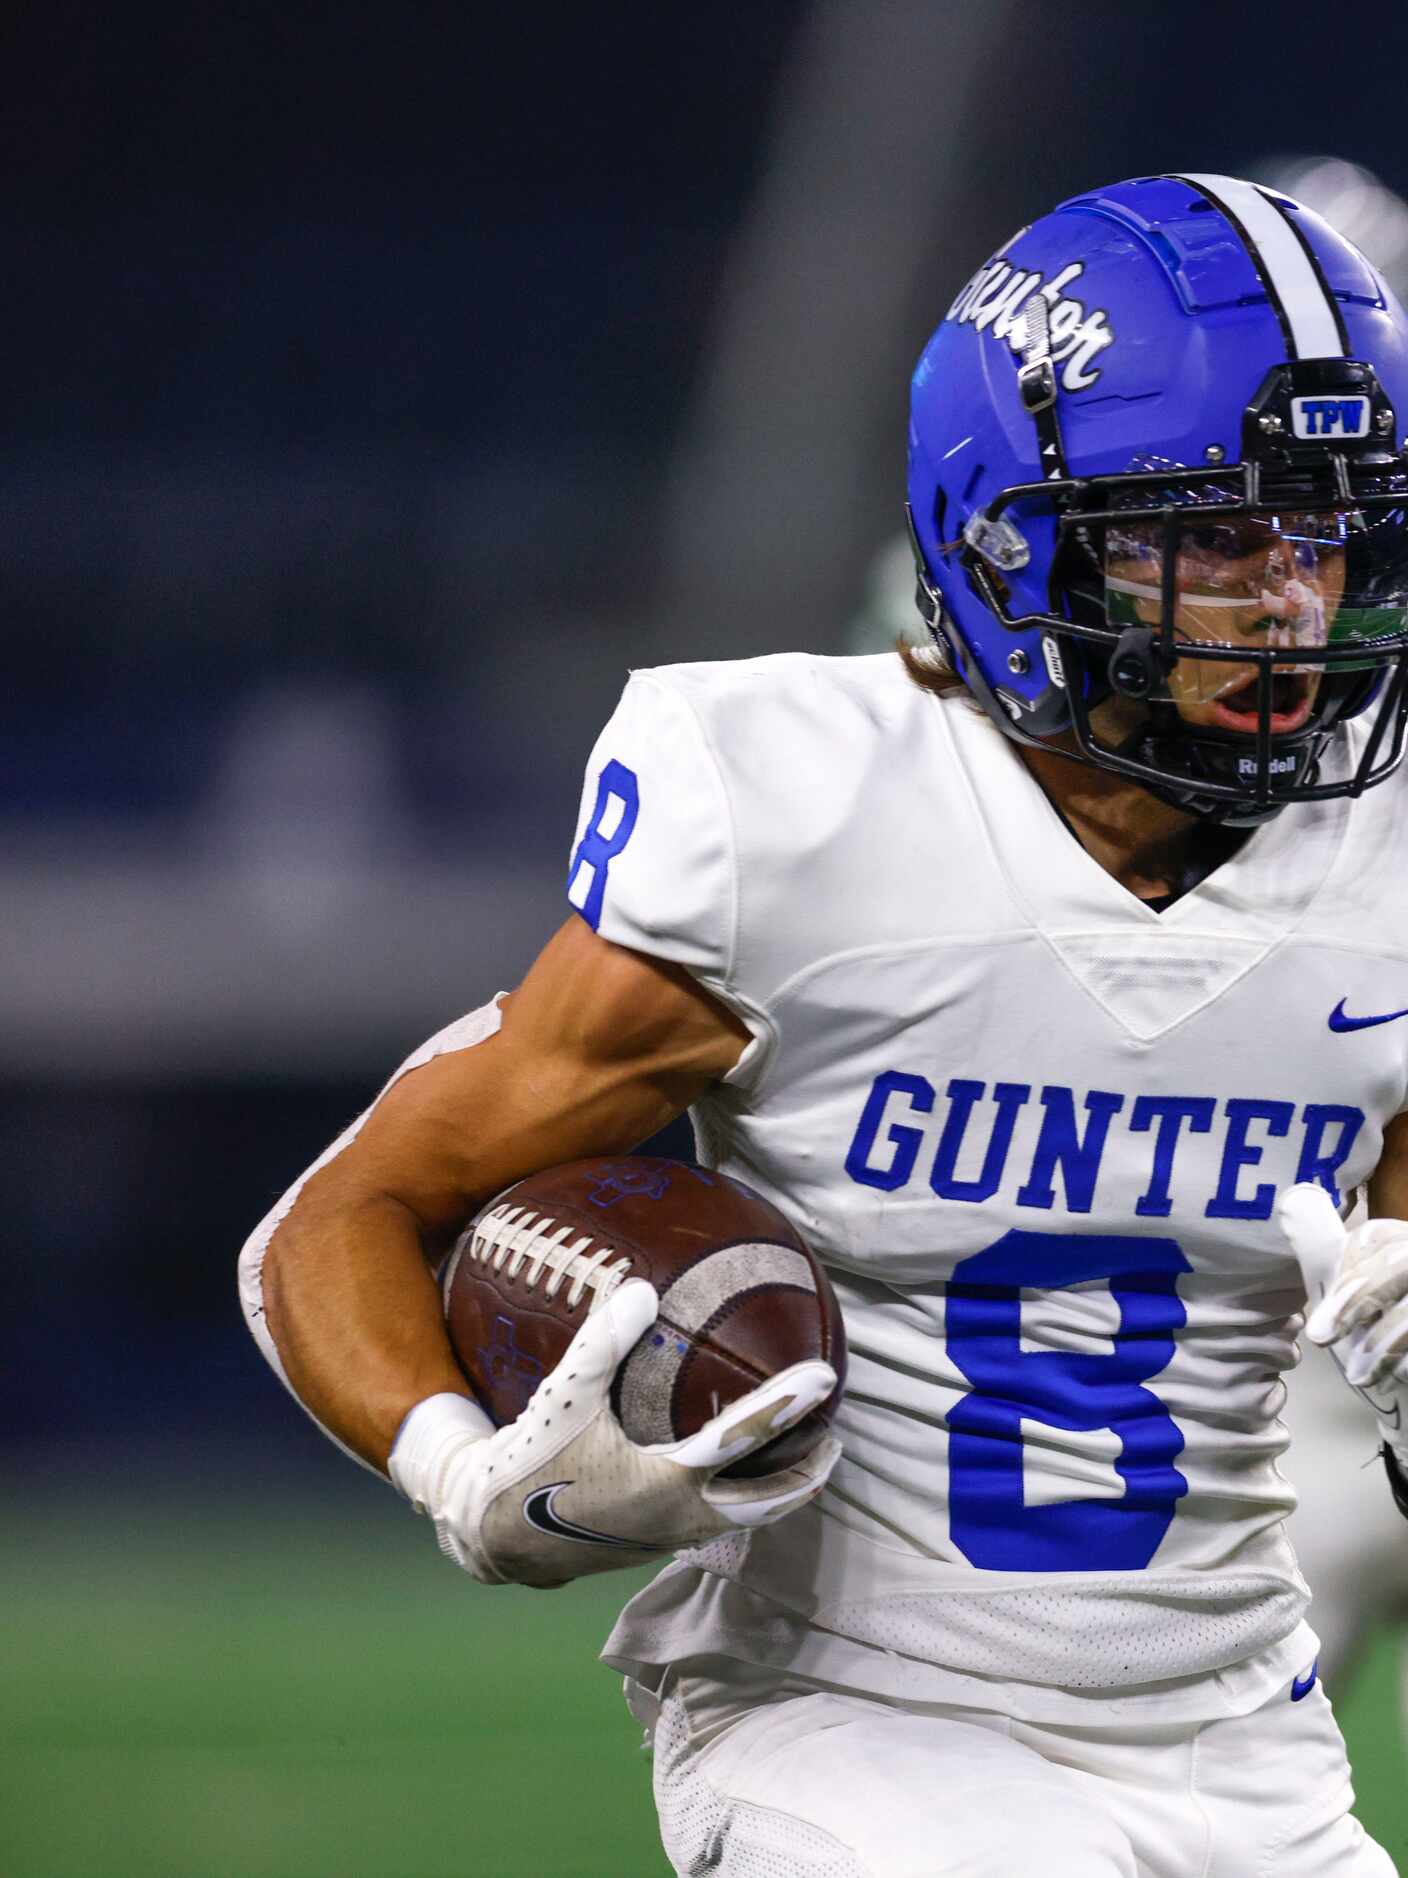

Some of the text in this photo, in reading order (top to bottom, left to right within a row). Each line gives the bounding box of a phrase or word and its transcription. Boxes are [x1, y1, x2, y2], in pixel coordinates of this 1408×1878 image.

[1300, 399, 1364, 435] TPW
[1238, 756, 1296, 775] Ridell
[843, 1069, 1366, 1221] GUNTER
[945, 1228, 1194, 1573] 8
